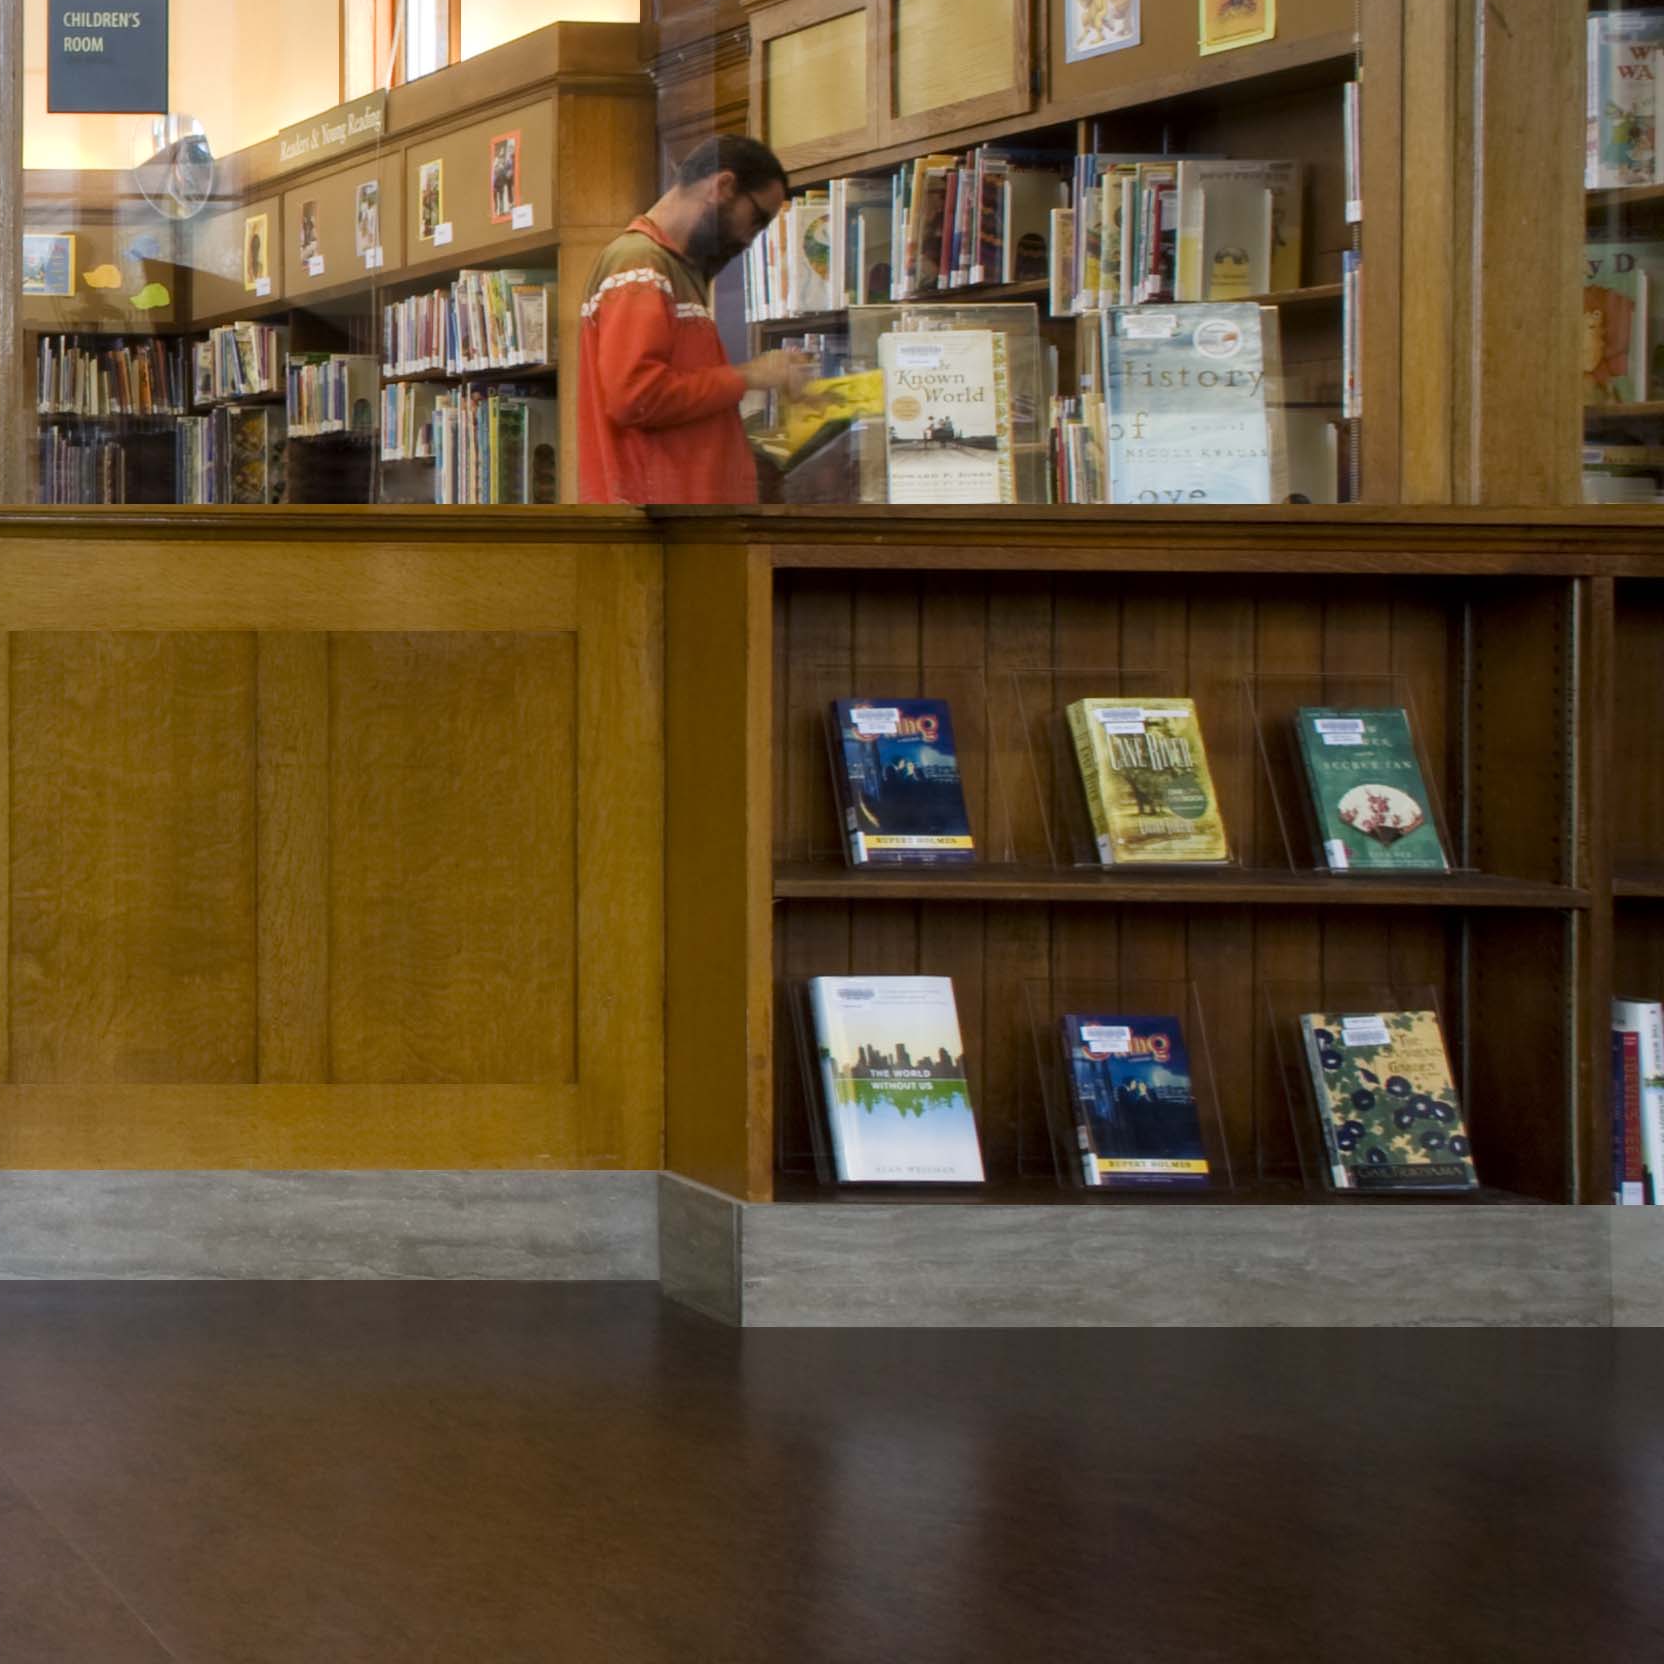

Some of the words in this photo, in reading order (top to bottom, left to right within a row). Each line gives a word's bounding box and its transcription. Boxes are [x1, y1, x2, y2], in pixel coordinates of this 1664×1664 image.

[63, 11, 141, 28] CHILDREN'S
[63, 36, 104, 53] ROOM
[895, 369, 965, 391] Known
[924, 387, 984, 403] World
[1109, 411, 1149, 440] of
[1145, 733, 1194, 771] RIVER
[870, 1069, 891, 1078] THE
[893, 1069, 931, 1078] WORLD
[871, 1082, 917, 1090] WITHOUT
[918, 1082, 933, 1090] US
